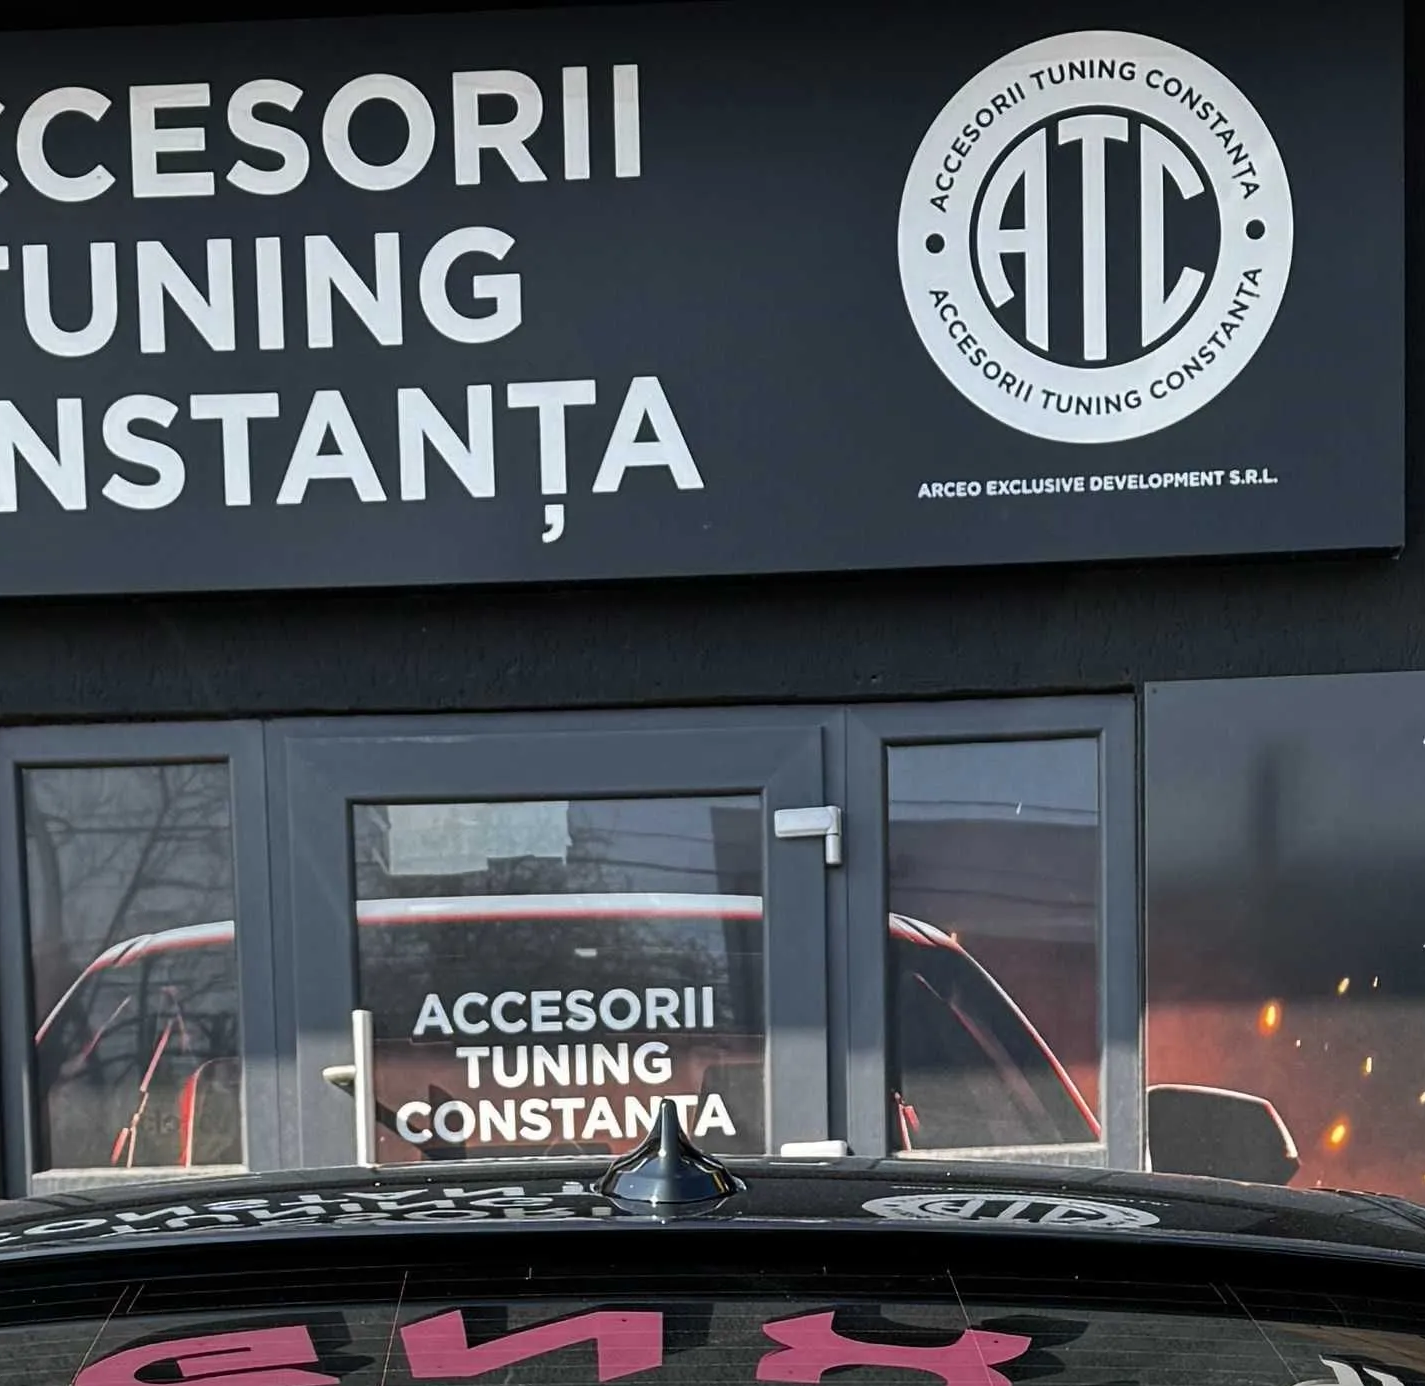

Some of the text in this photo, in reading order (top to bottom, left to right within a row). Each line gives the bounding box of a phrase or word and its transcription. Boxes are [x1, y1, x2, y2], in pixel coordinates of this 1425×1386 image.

[929, 82, 1026, 213] ACCESORII
[1029, 59, 1137, 91] TUNING
[976, 113, 1206, 361] ATC
[928, 290, 1033, 403] ACCESORII
[1041, 389, 1142, 415] TUNING
[917, 468, 1279, 499] ARCEO EXCLUSIVE DEVELOPMENT S.R.L.
[413, 986, 714, 1036] ACCESORII
[455, 1041, 673, 1089] TUNING
